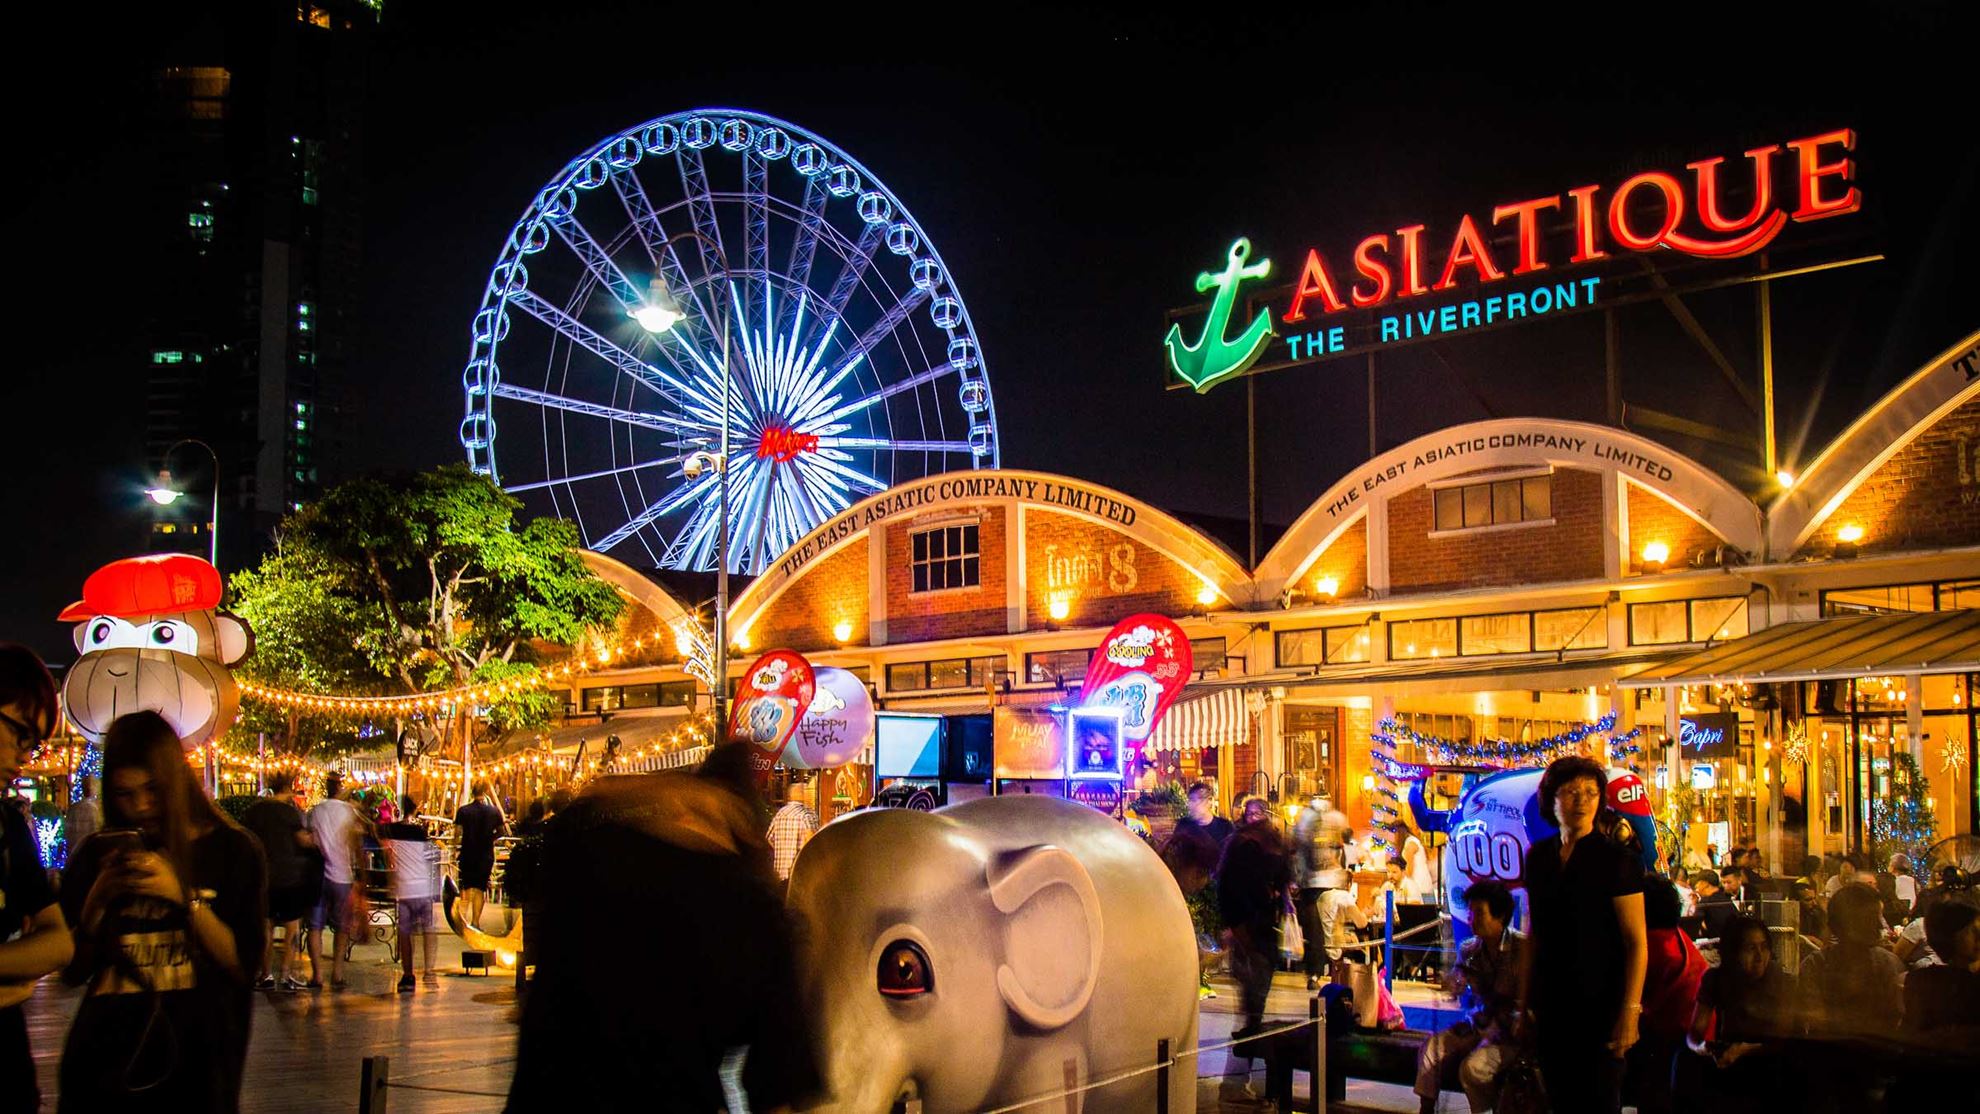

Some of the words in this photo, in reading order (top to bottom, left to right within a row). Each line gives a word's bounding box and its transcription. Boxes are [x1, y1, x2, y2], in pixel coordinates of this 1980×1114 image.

[1281, 127, 1861, 325] ASIATIQUE
[1286, 326, 1346, 361] THE
[1380, 277, 1601, 342] RIVERFRONT
[1326, 487, 1360, 518] THE
[1363, 461, 1408, 492] EAST
[1412, 437, 1485, 470] ASIATIC
[1488, 434, 1587, 453] COMPANY
[1593, 442, 1674, 483] LIMITED
[781, 542, 814, 577] THE
[817, 515, 861, 553] EAST
[864, 485, 935, 526] ASIATIC
[939, 478, 1039, 500] COMPANY
[1043, 483, 1137, 527] LIMITED
[1108, 542, 1138, 594] 8
[800, 716, 848, 732] Happy
[800, 731, 844, 748] Fish
[1680, 717, 1724, 752] Capri
[1457, 831, 1524, 883] 100
